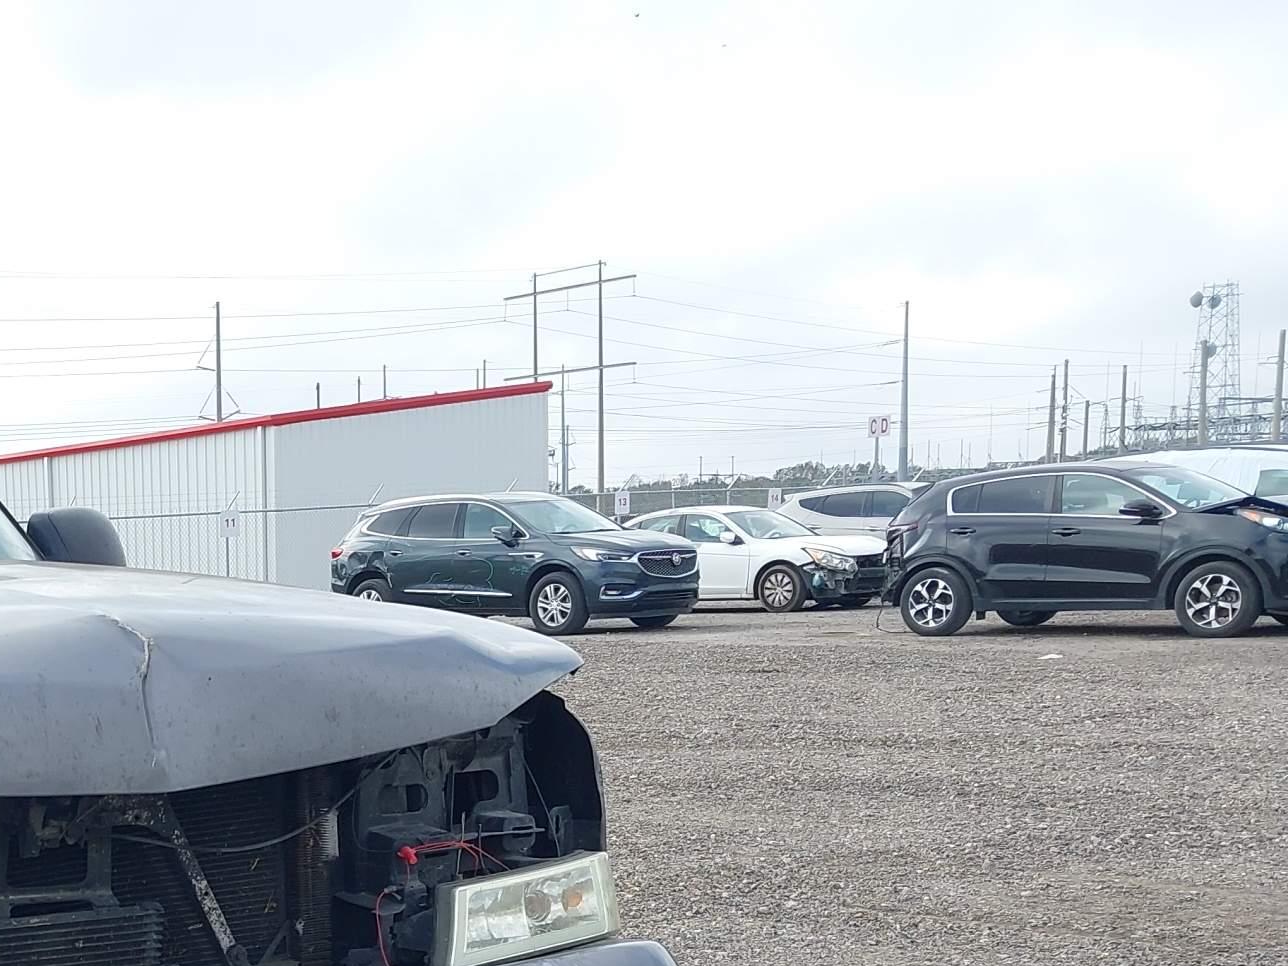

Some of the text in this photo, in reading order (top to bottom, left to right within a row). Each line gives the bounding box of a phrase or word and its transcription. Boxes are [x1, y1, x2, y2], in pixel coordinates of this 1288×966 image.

[870, 418, 889, 434] C D
[618, 498, 627, 506] 13
[224, 518, 236, 528] 11
